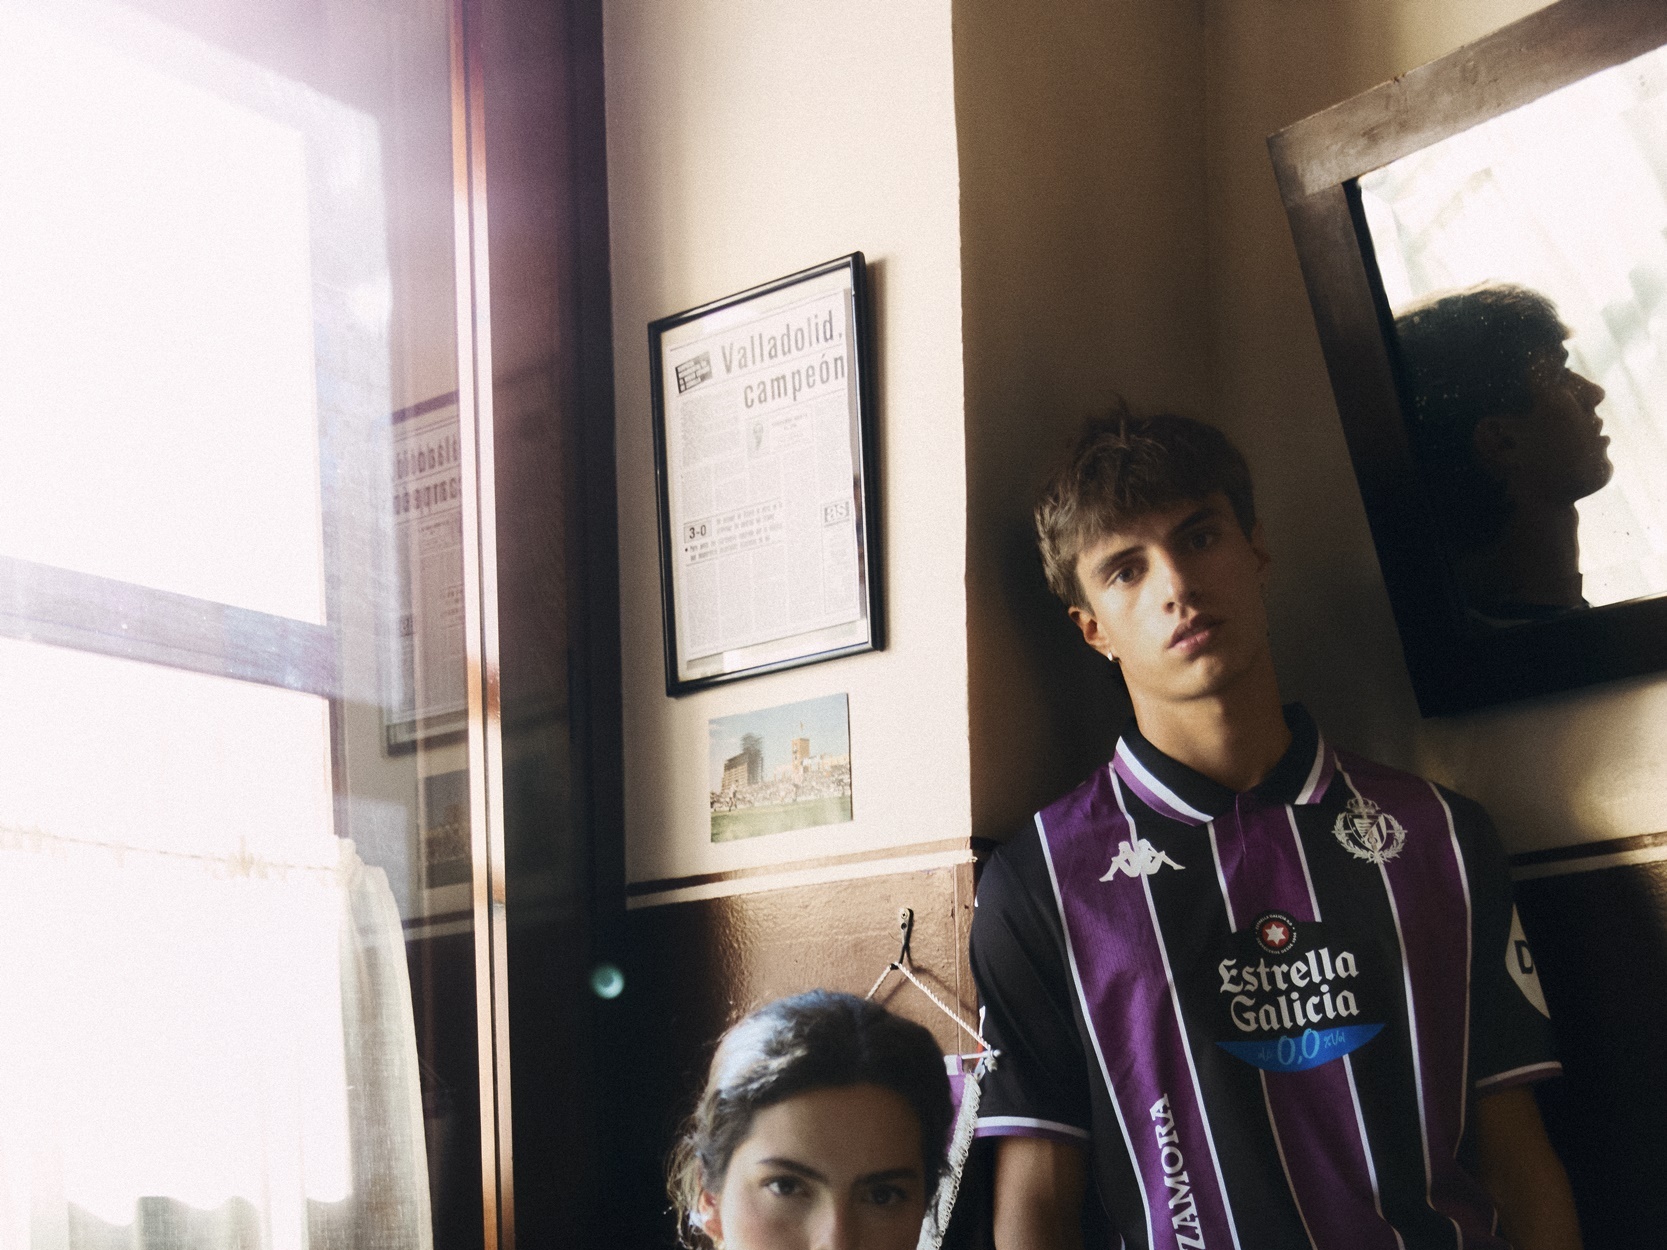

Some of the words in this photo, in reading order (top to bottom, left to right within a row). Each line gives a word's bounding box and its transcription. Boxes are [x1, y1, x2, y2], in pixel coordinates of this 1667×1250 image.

[743, 353, 845, 409] campeón
[688, 524, 707, 540] 3-0
[1218, 947, 1360, 994] Estrella
[1230, 983, 1360, 1033] Galicia
[1277, 1028, 1320, 1066] 0,0
